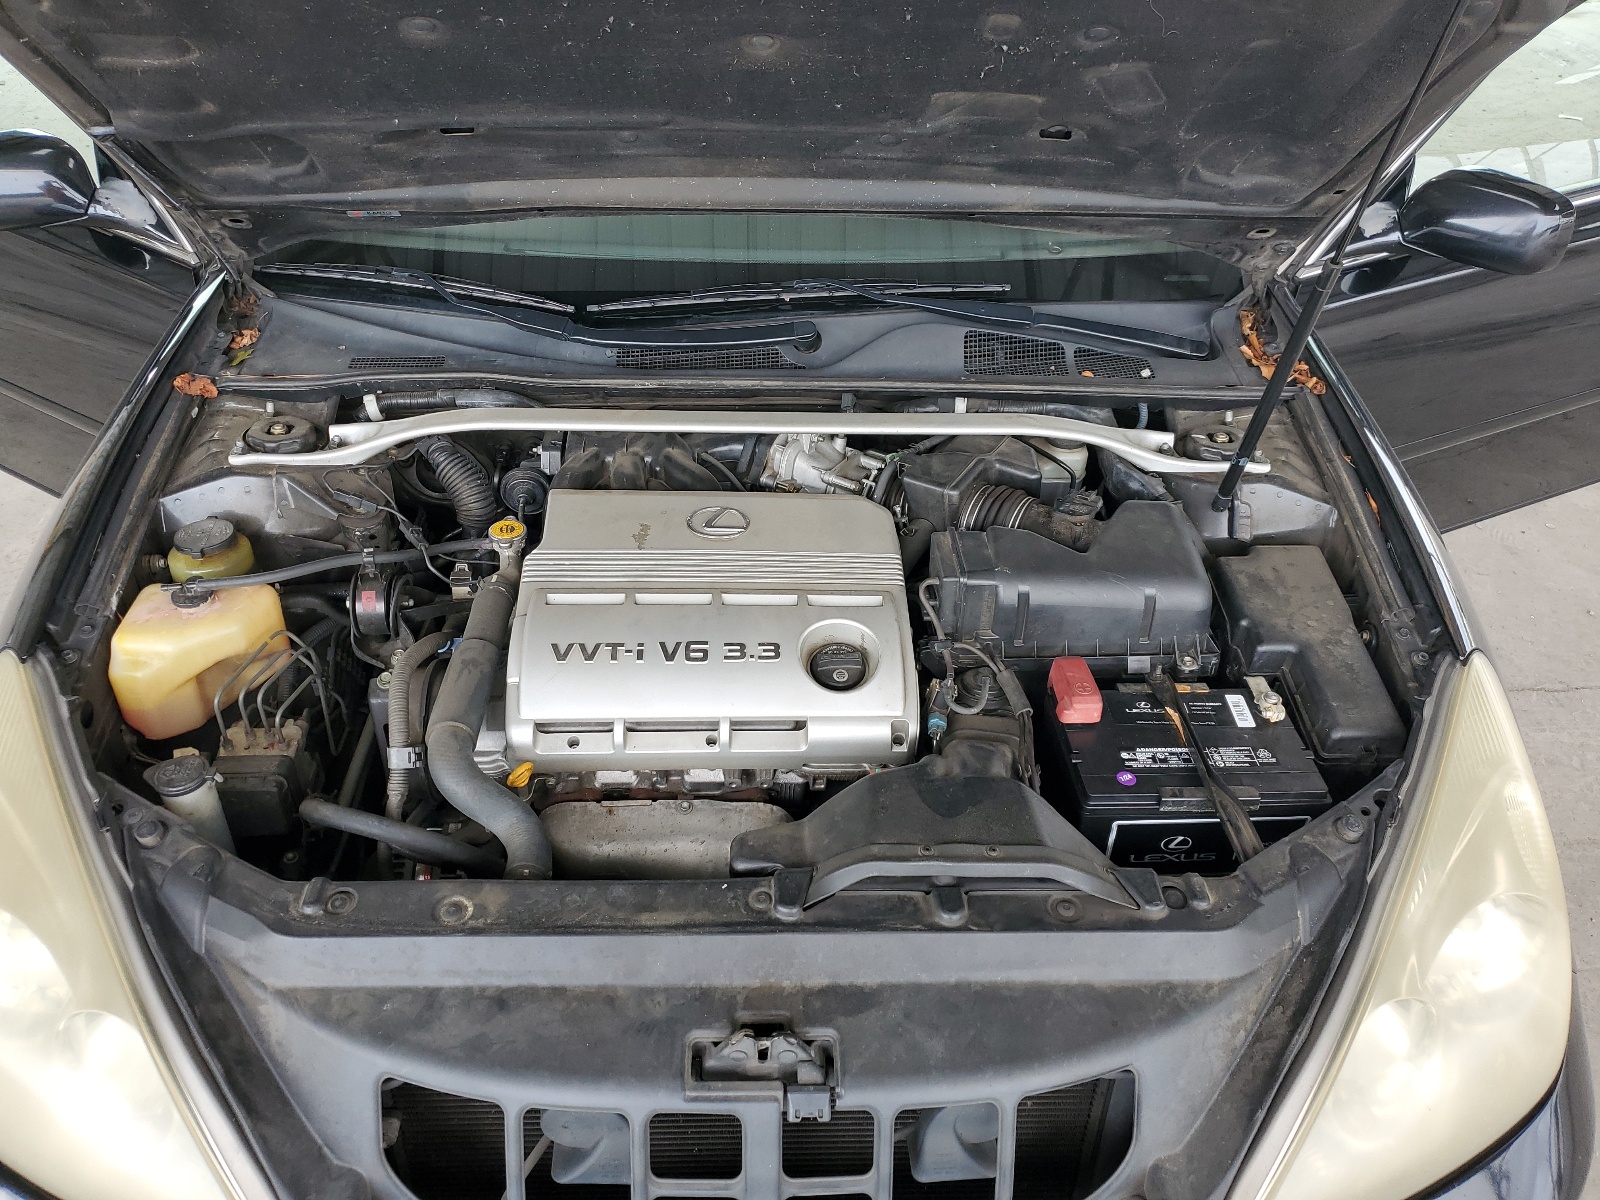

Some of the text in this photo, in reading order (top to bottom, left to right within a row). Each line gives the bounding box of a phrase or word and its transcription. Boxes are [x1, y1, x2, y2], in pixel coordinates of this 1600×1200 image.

[550, 640, 781, 665] VVT-i V6 3.3
[1130, 852, 1216, 863] LEXUS
